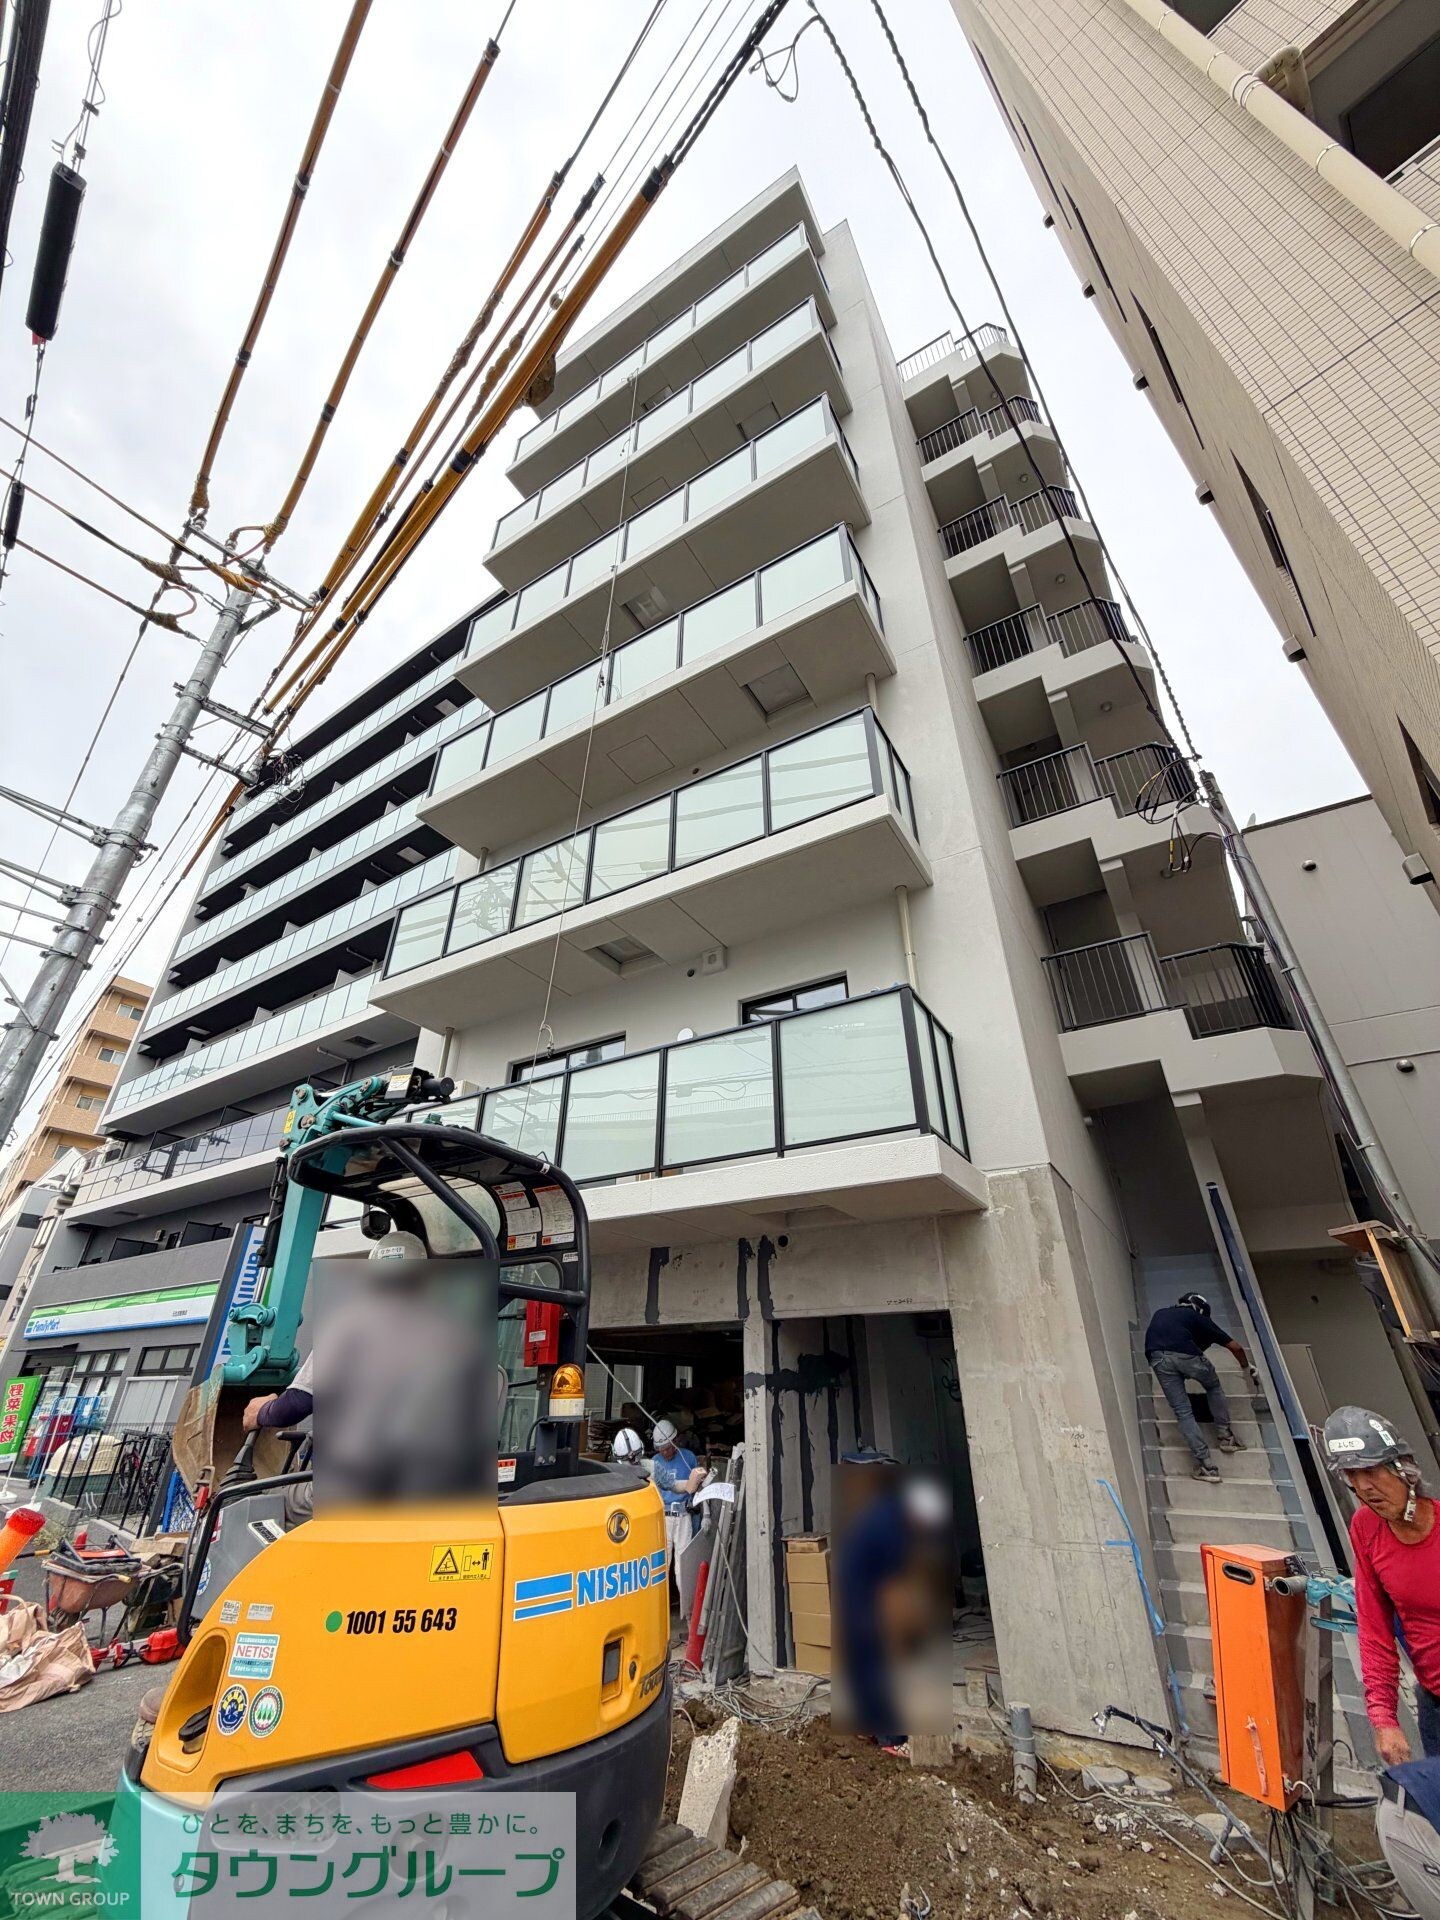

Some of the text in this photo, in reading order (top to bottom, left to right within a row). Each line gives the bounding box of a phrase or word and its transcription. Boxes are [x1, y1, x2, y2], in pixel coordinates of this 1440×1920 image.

[577, 1556, 650, 1607] NISHIO
[346, 1607, 458, 1635] 1001 55 643
[235, 1645, 270, 1659] NETIS
